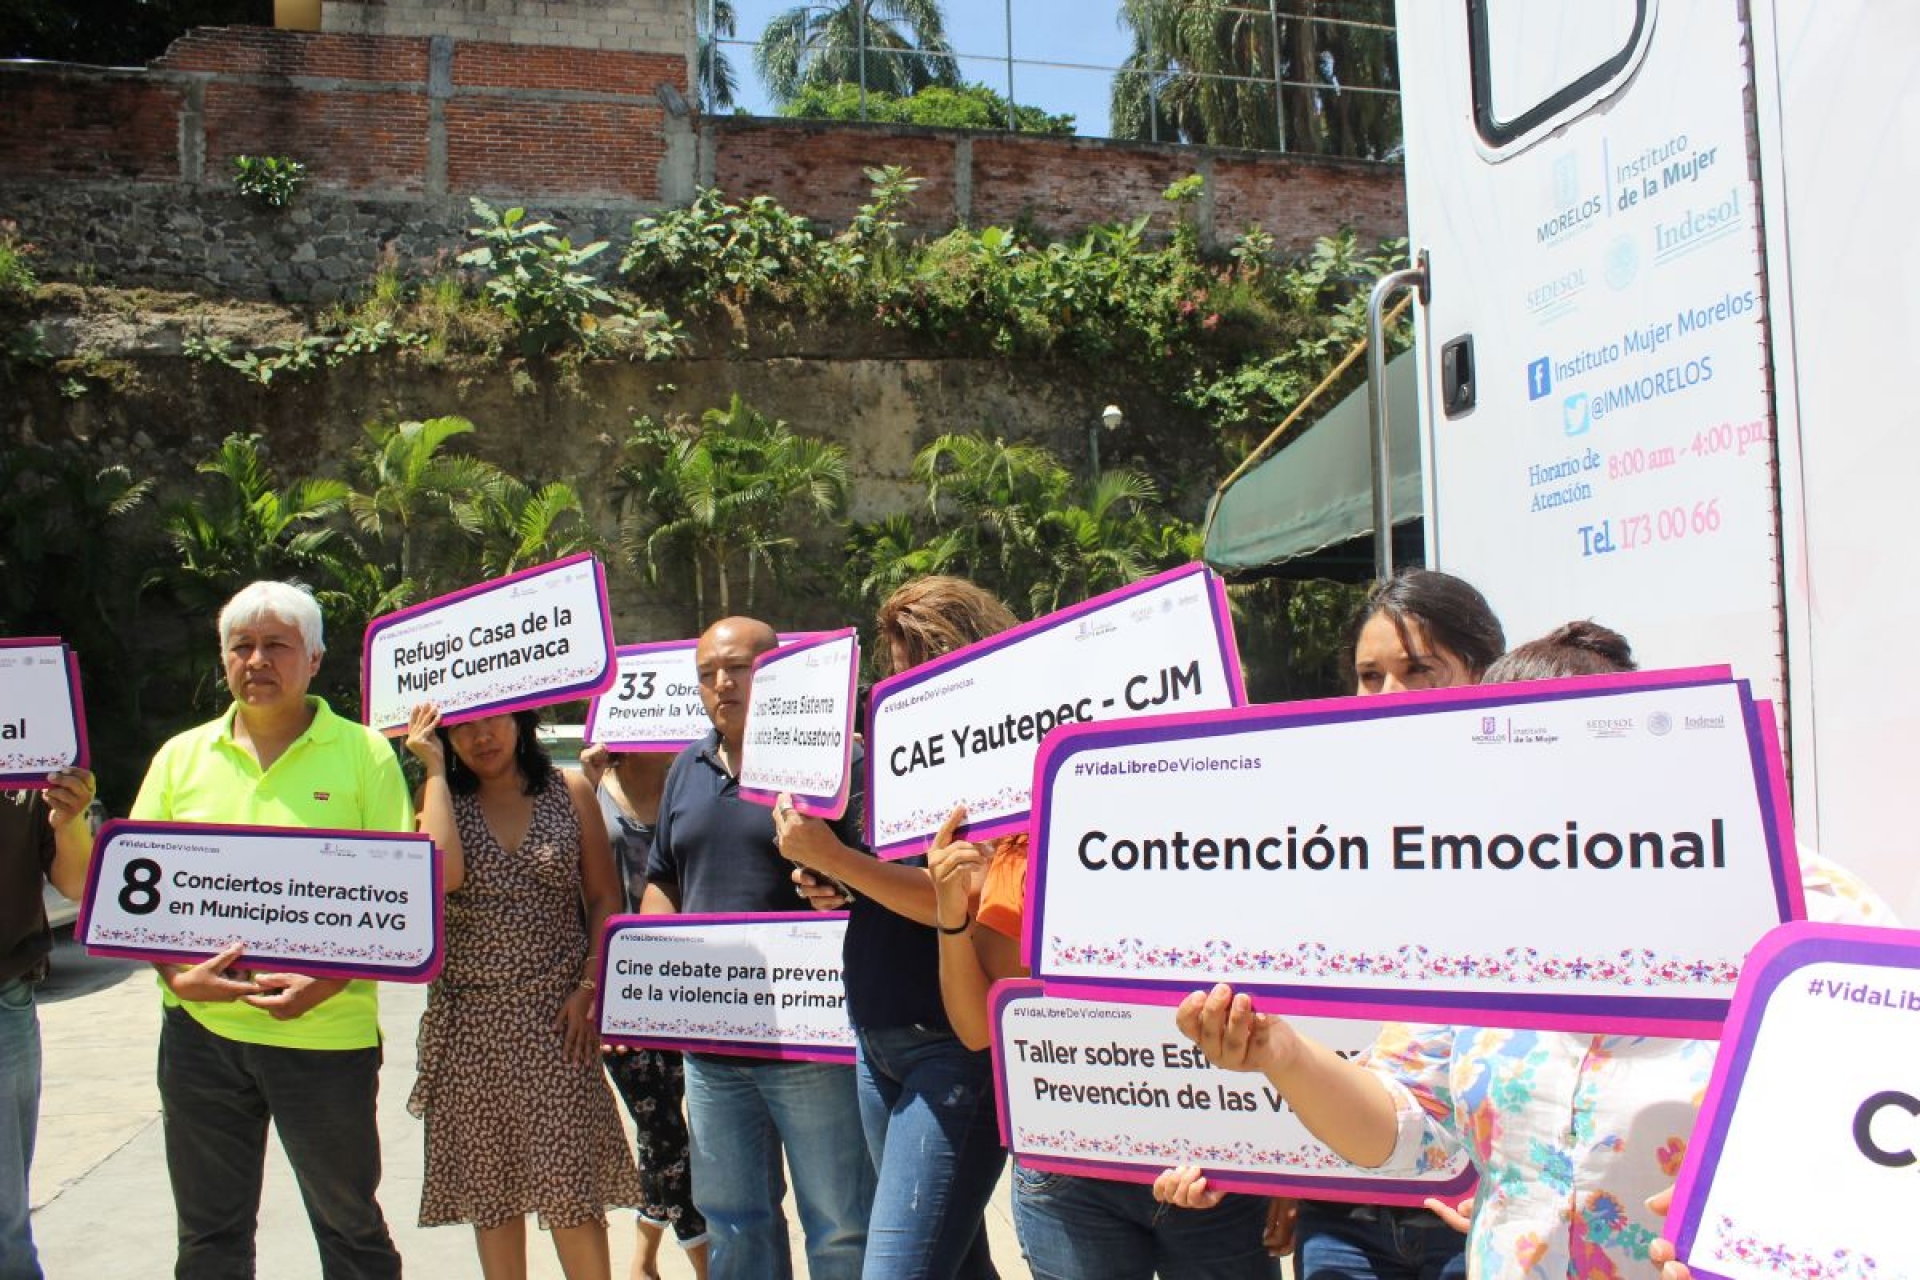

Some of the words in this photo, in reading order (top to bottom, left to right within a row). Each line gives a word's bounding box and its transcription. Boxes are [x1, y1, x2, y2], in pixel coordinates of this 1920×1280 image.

[1617, 134, 1688, 184] Instituto
[1618, 188, 1638, 212] de
[1642, 177, 1658, 200] la
[1662, 146, 1717, 188] Mujer
[1537, 195, 1602, 244] MORELOS
[1654, 188, 1741, 250] Indesol
[1525, 269, 1587, 309] SEDESOL
[1554, 344, 1619, 382] Instituto
[1624, 322, 1674, 357] Mujer
[1677, 290, 1754, 337] Morelos
[1591, 356, 1713, 420] @IMMORELOS
[1529, 457, 1580, 487] Horario
[1583, 448, 1601, 469] de
[1608, 448, 1645, 480] 8:00
[1649, 447, 1676, 470] am
[1691, 422, 1732, 456] 4:00
[1531, 482, 1592, 512] Atención
[1620, 512, 1652, 550] 173
[1657, 507, 1686, 541] 00
[1691, 499, 1721, 534] 66
[394, 633, 463, 669] Refugio
[469, 623, 516, 648] Casa
[521, 612, 547, 635] de
[554, 606, 572, 628] la
[397, 667, 447, 694] Mujer
[451, 637, 570, 679] Cuernavaca
[618, 671, 657, 701] 33
[800, 694, 834, 715] Sistema
[609, 704, 665, 720] Prevenir
[669, 704, 681, 717] la
[890, 734, 945, 777] CAE
[952, 698, 1093, 758] Yautepec
[1102, 698, 1115, 708] -
[1124, 660, 1202, 711] CJM
[792, 726, 841, 748] Acusatorio
[1074, 755, 1262, 776] #VidaLibreDeViolencias
[1078, 823, 1369, 871] Contención
[1393, 818, 1726, 870] Emocional
[118, 857, 162, 915] 8
[173, 871, 282, 897] Conciertos
[288, 878, 409, 904] interactivos
[169, 902, 193, 915] en
[200, 899, 309, 925] Municipios
[314, 912, 352, 927] con
[357, 911, 407, 931] AVG
[616, 960, 654, 977] Cine
[659, 961, 722, 979] debate
[727, 966, 766, 982] para
[622, 984, 643, 1000] de
[648, 984, 663, 1001] la
[669, 986, 748, 1005] violencia
[754, 992, 776, 1006] en
[1013, 1006, 1132, 1020] #VidaLibreDeViolencias
[1014, 1039, 1077, 1064] Taller
[1085, 1041, 1154, 1068] sobre
[1034, 1077, 1170, 1108] Prevención
[1177, 1083, 1211, 1110] de
[1217, 1084, 1257, 1112] las
